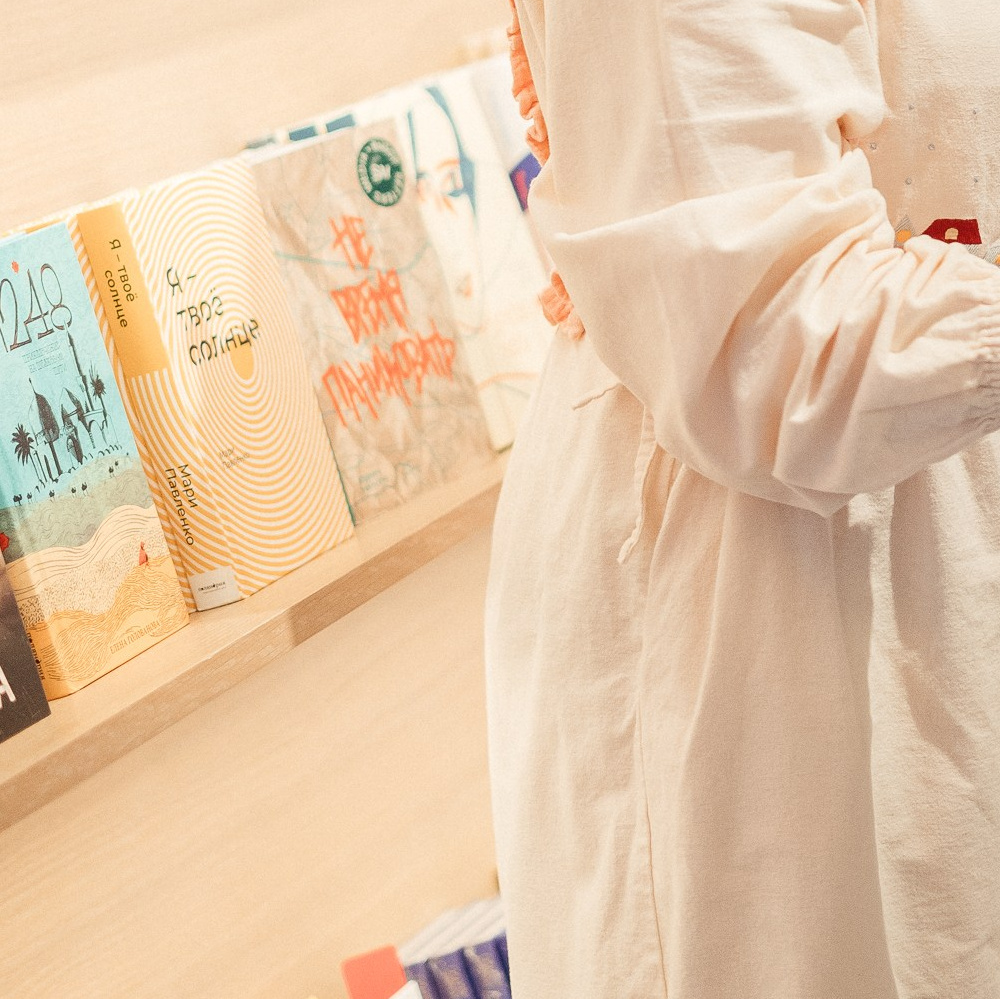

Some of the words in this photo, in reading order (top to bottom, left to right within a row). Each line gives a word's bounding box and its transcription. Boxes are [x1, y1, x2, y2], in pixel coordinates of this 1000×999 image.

[109, 239, 121, 250] Я
[118, 265, 138, 302] твоё
[330, 215, 374, 271] НЕ
[0, 263, 73, 352] 248
[104, 269, 128, 328] солнце
[166, 267, 183, 296] Я
[176, 287, 224, 332] твоё
[330, 267, 410, 344] ВРЕМЯ
[189, 318, 261, 366] солнце
[322, 317, 456, 427] ПАНИКОВАТЬ
[165, 468, 194, 546] Павленко
[177, 464, 198, 508] Мари
